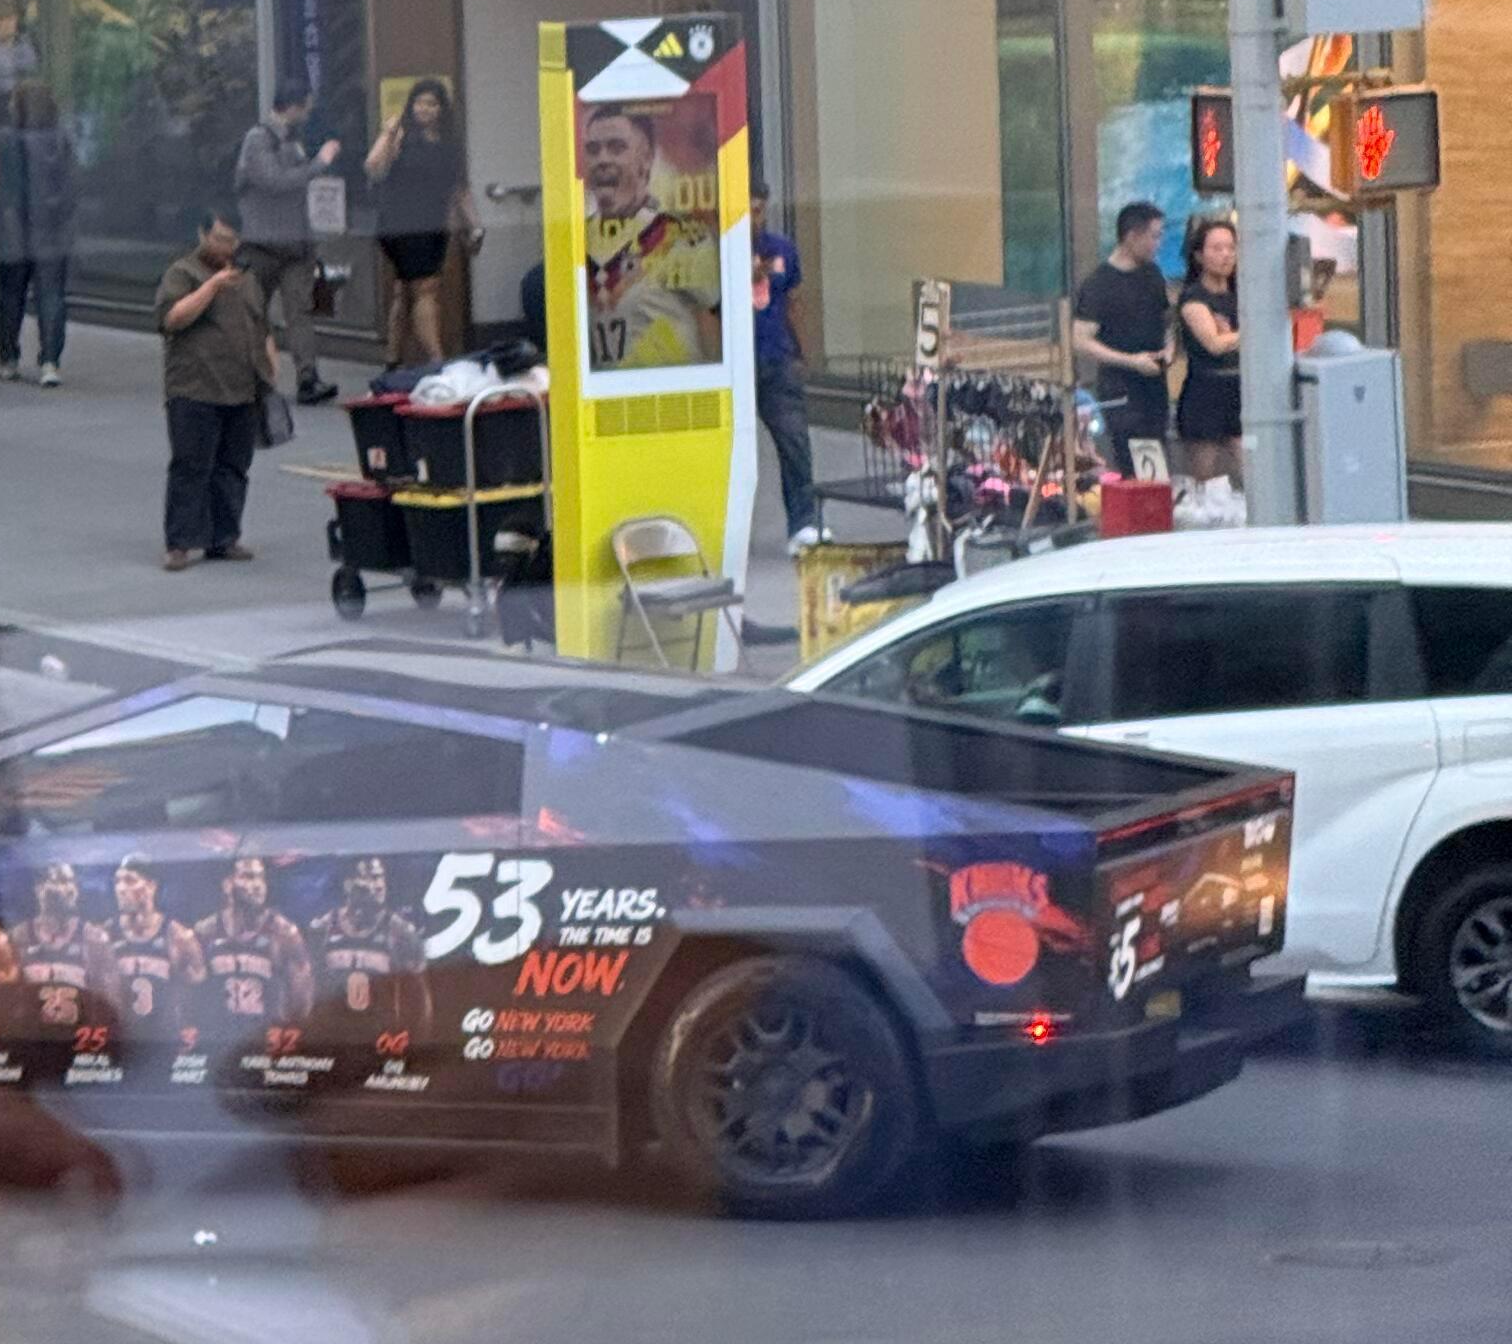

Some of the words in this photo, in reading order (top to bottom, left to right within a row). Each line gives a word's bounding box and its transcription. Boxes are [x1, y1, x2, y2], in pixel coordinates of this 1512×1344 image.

[422, 852, 555, 966] 53
[559, 925, 592, 947] THE
[593, 924, 632, 947] TIME
[633, 925, 654, 946] IS
[461, 1006, 496, 1034] GO
[494, 1010, 542, 1033] NEW
[542, 1011, 597, 1033] YORK
[72, 1026, 110, 1053] 25
[462, 1034, 495, 1062] GO
